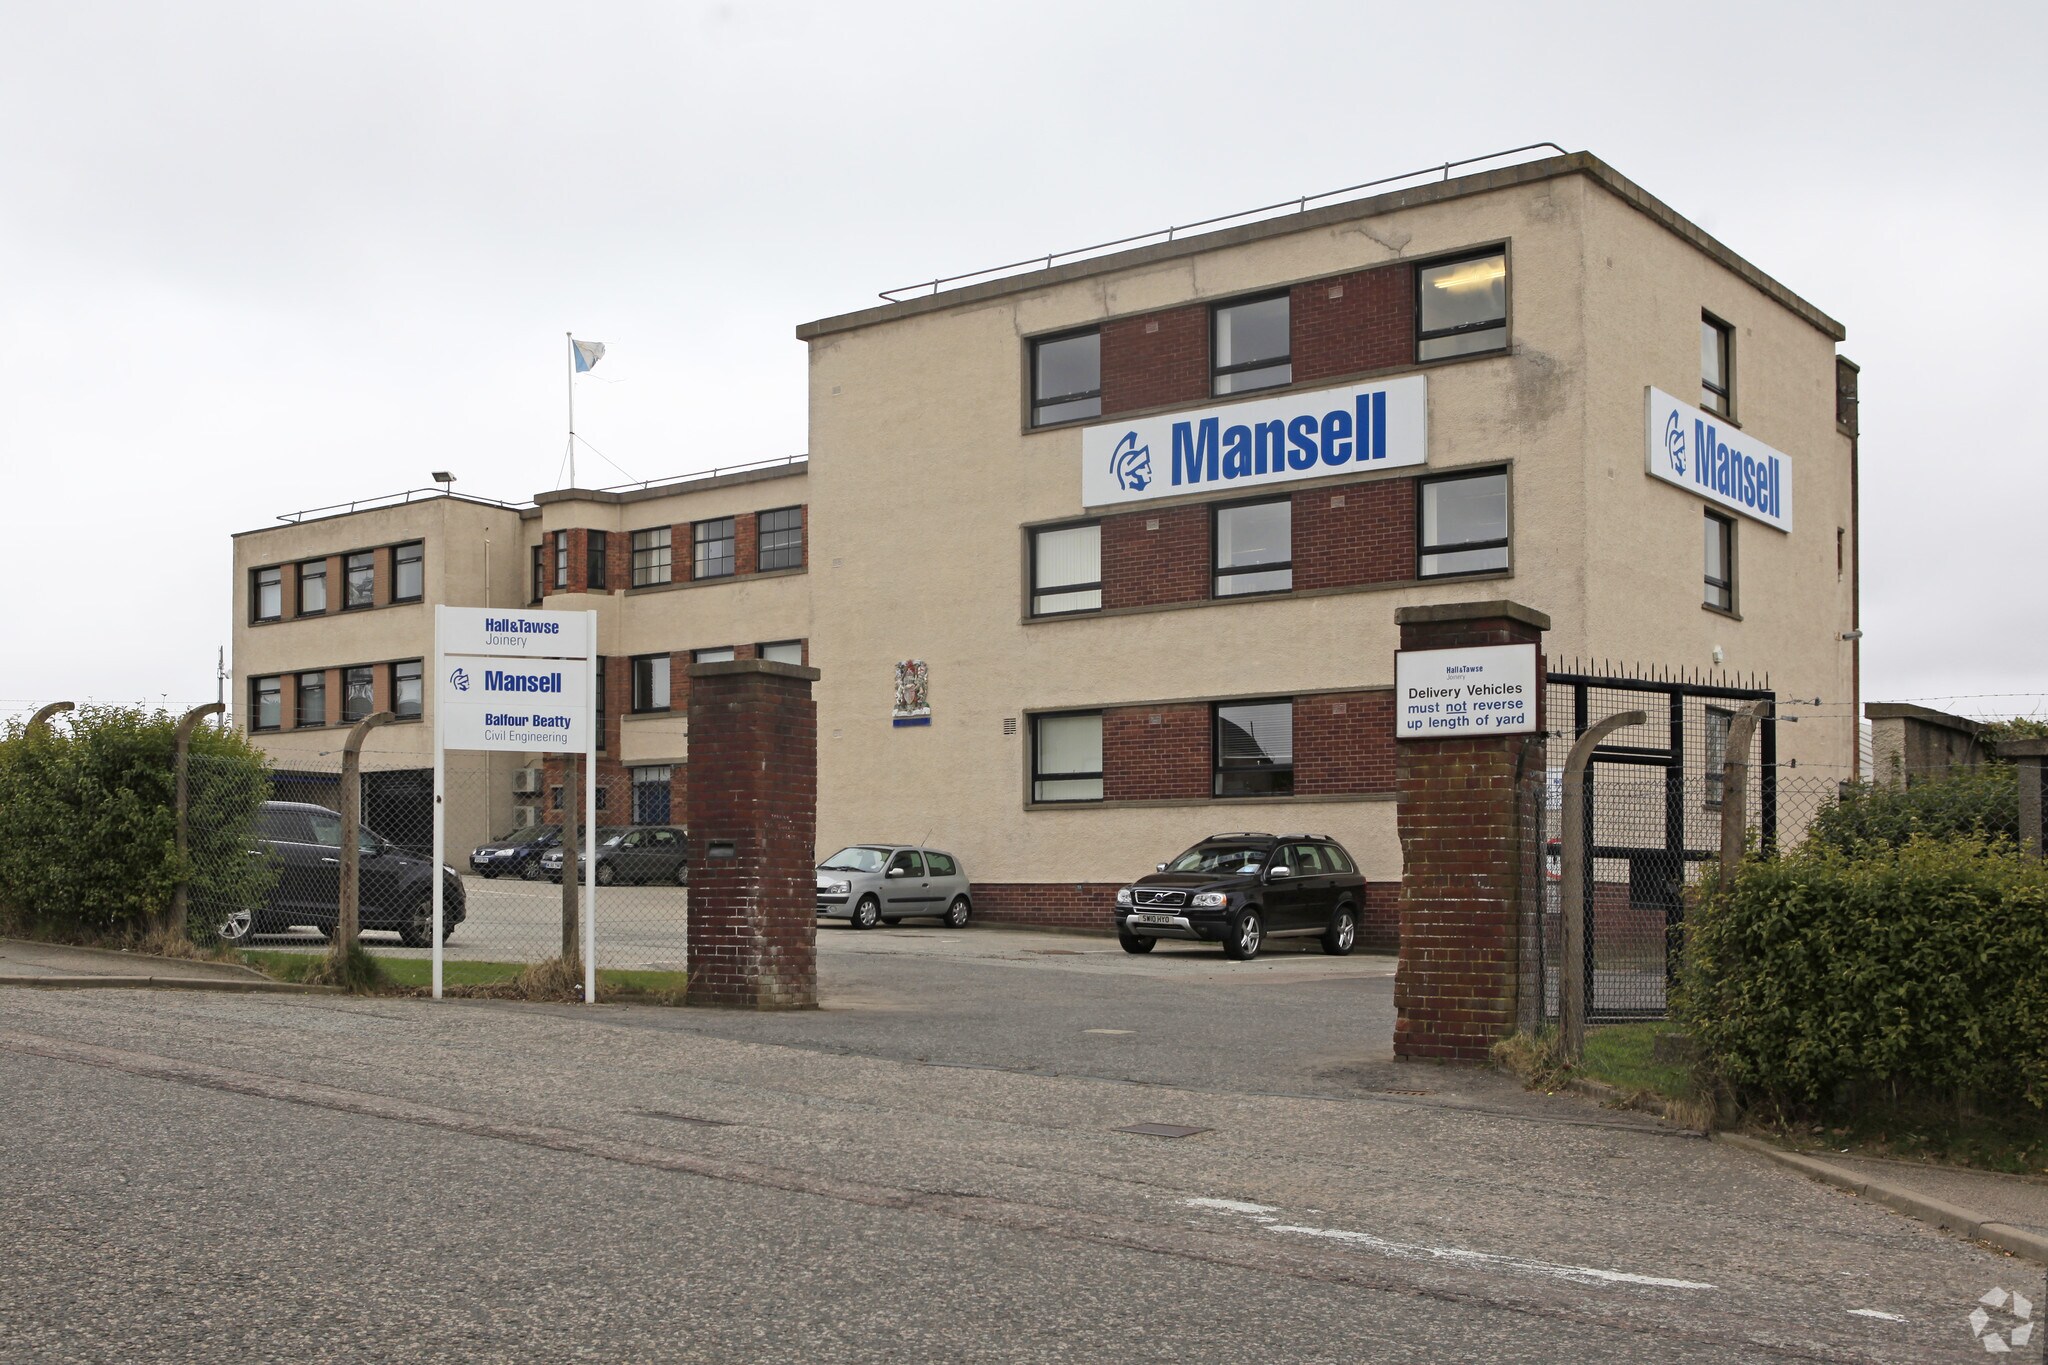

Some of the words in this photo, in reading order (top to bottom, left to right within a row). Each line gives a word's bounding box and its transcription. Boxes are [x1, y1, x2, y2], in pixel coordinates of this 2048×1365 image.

[1171, 391, 1387, 486] Mansell
[1694, 418, 1780, 519] Mansell
[485, 618, 559, 634] Hall&Tawse
[485, 633, 527, 648] Joinery
[1446, 665, 1484, 674] Hall&Tawse
[485, 670, 562, 693] Mansell
[1408, 687, 1461, 699] Delivery
[1467, 683, 1523, 696] Vehicles
[1408, 702, 1440, 714] must
[1446, 701, 1467, 714] not
[1473, 700, 1523, 711] reverse
[485, 713, 529, 727] Balfour
[532, 714, 571, 729] Beatty
[1407, 719, 1423, 730] up
[1428, 715, 1469, 729] length
[1475, 714, 1489, 726] of
[1496, 713, 1525, 727] yard
[484, 729, 506, 741] Civil
[509, 730, 568, 744] Engineering
